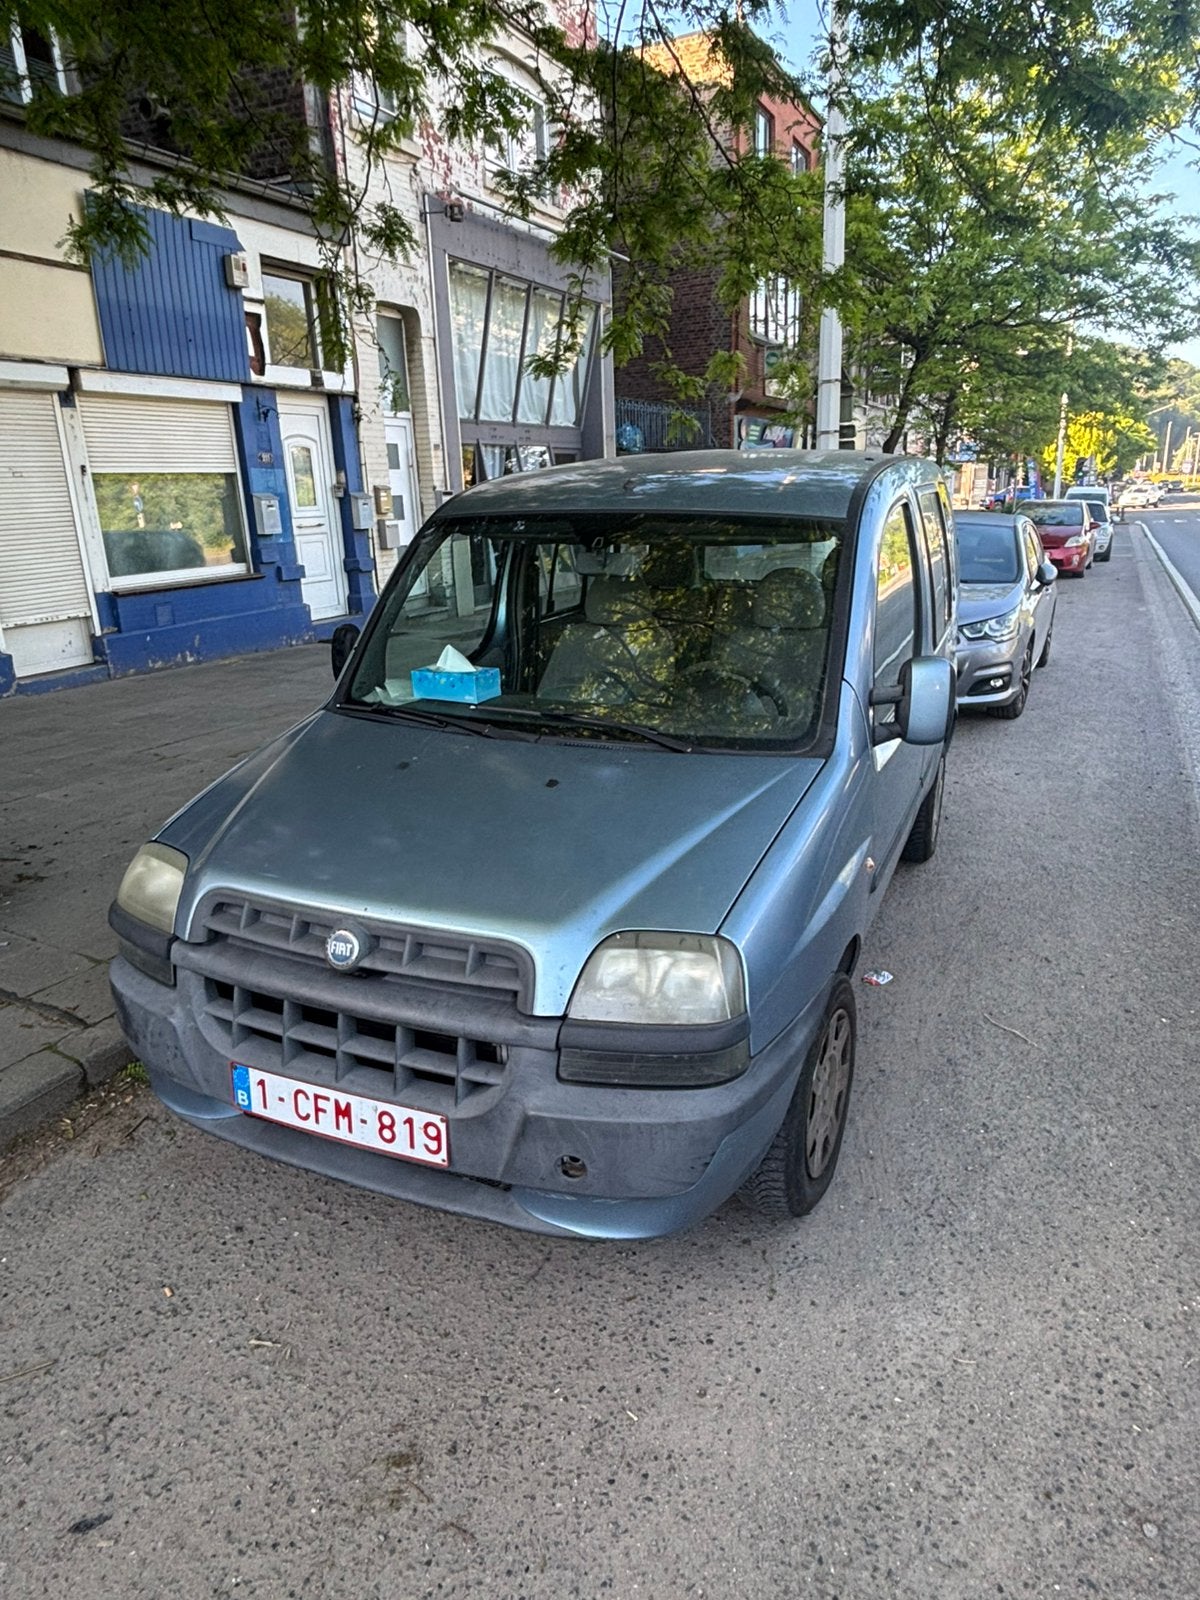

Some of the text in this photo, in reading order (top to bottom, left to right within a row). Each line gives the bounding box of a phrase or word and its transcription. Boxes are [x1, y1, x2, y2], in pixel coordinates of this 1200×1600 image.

[331, 940, 353, 957] FIAT
[237, 1089, 249, 1106] B
[256, 1078, 443, 1156] 1-CFM-819
